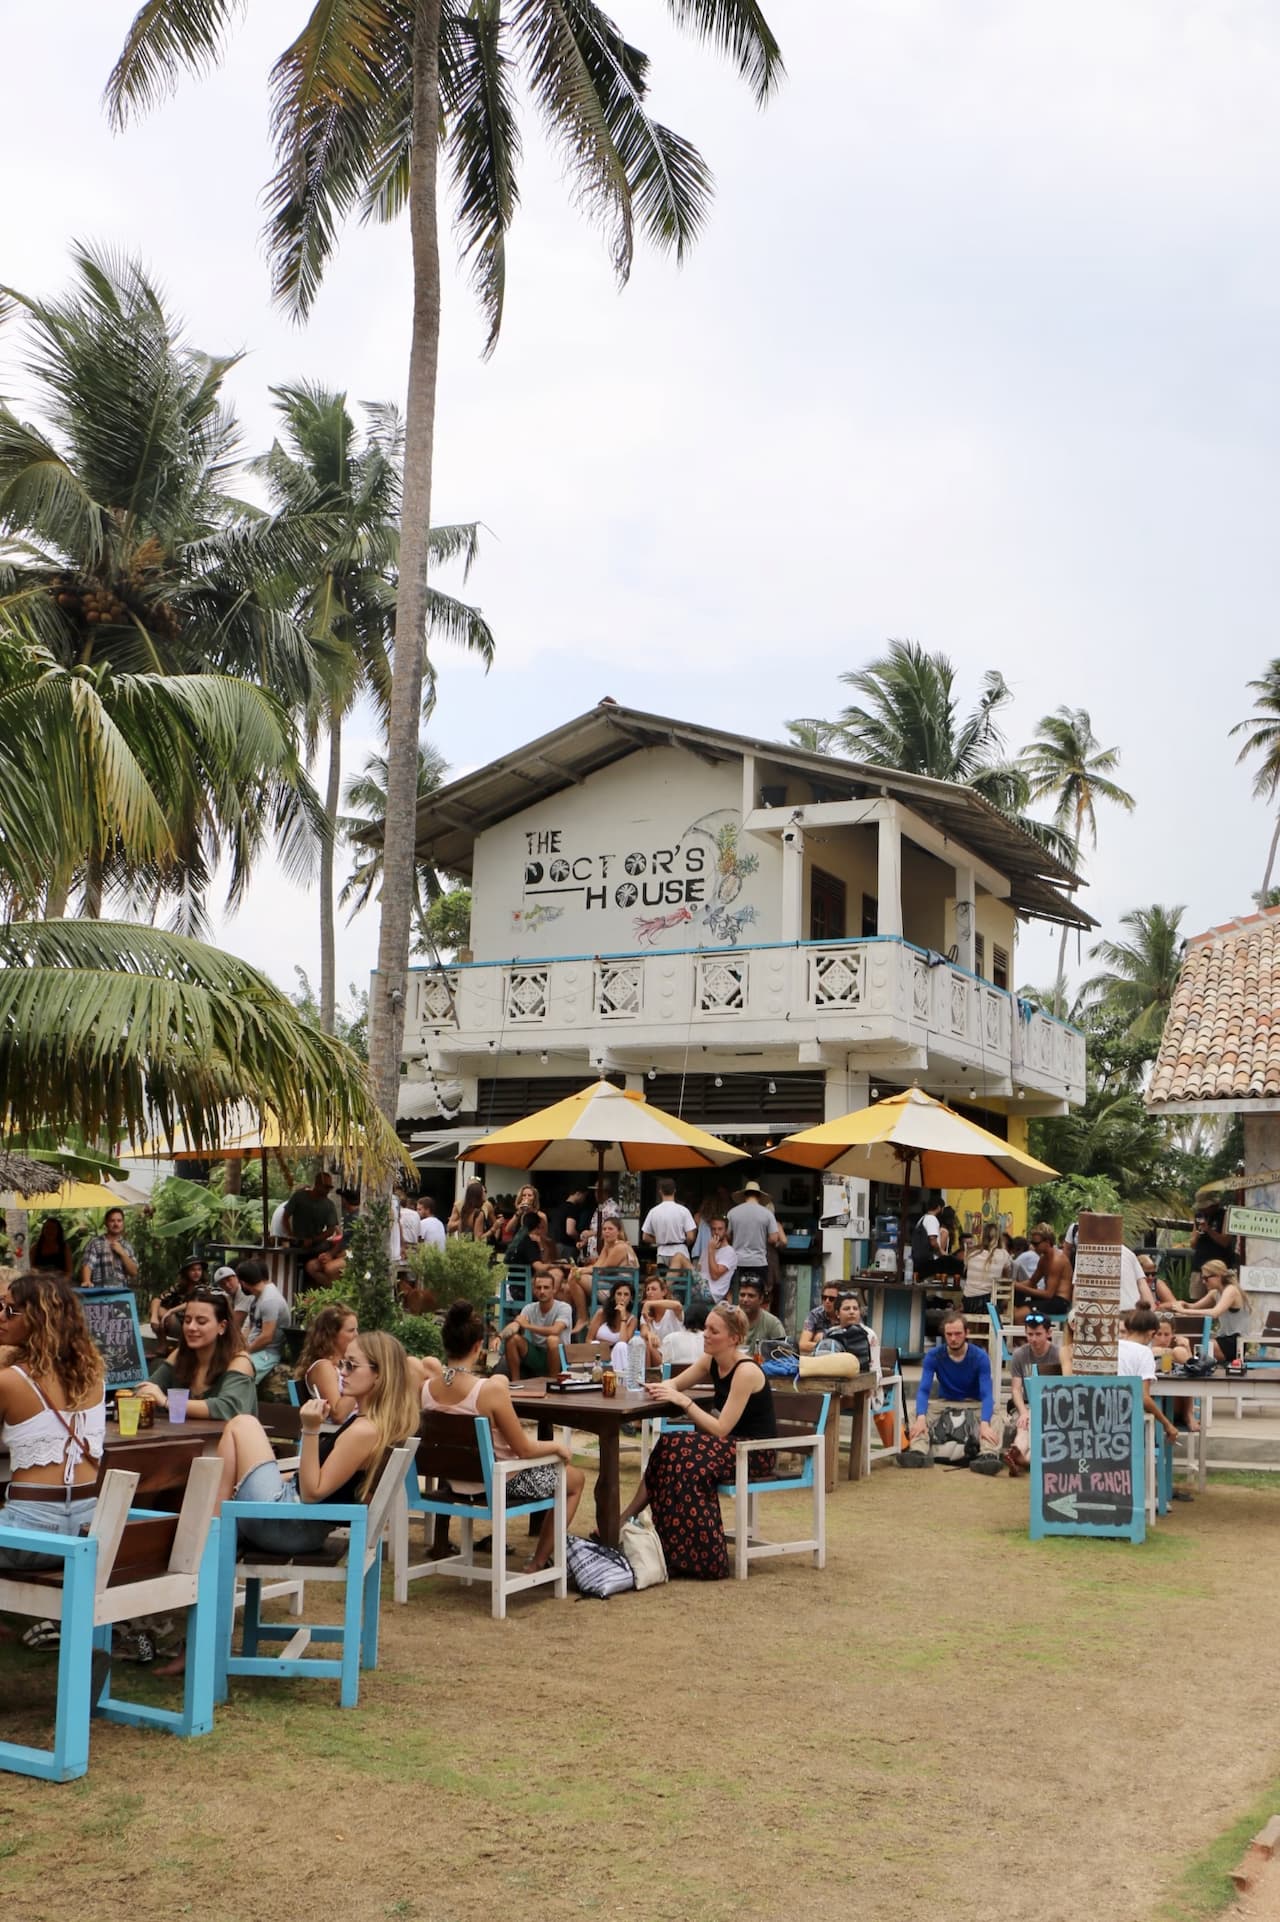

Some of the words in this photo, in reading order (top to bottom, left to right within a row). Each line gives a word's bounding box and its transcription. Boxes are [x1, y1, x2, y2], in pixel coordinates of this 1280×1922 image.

[524, 830, 562, 855] THE
[524, 845, 705, 885] DOCTOR'S
[585, 878, 705, 910] HOUSE
[105, 1331, 134, 1345] RUM
[1041, 1387, 1089, 1430] ICE
[1092, 1388, 1132, 1433] COLD
[1041, 1430, 1130, 1463] BEERS
[1078, 1458, 1090, 1474] &
[1043, 1472, 1083, 1495] RUM
[1090, 1470, 1131, 1496] PUNCH
